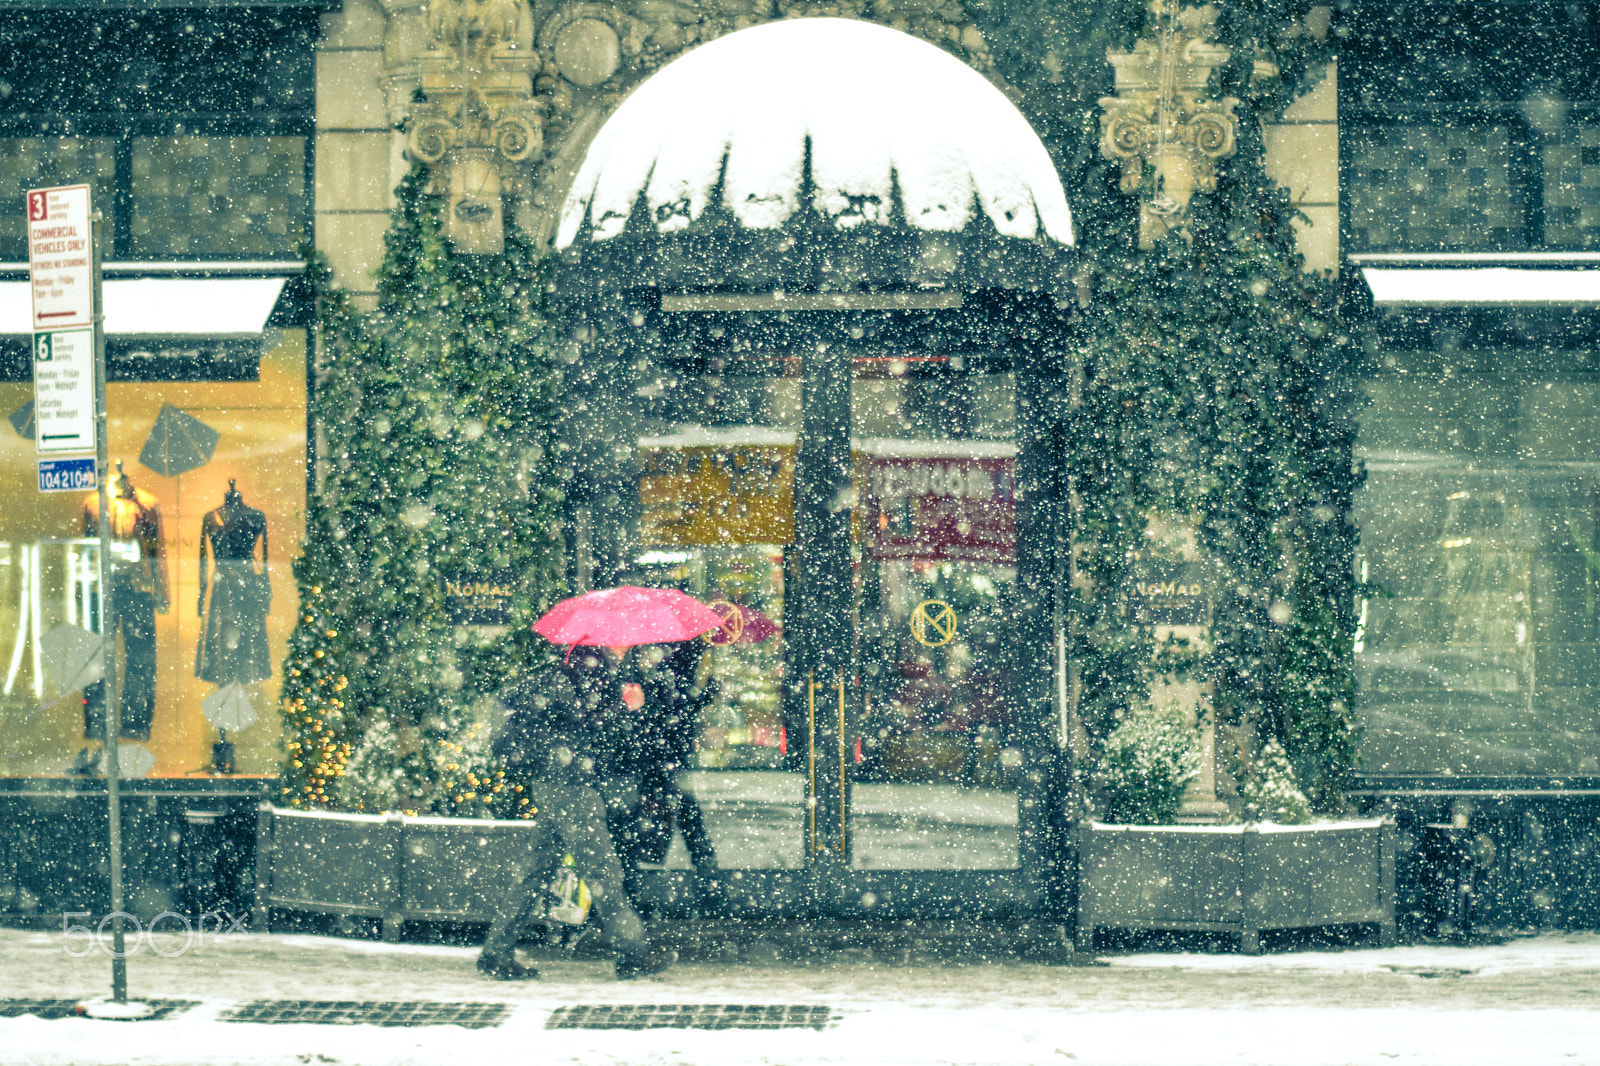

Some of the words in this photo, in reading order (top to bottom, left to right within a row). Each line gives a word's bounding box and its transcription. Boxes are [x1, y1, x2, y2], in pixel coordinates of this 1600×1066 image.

[33, 193, 43, 220] 3
[33, 226, 78, 240] COMMERCIAL
[33, 241, 65, 254] VEHICLES
[68, 240, 85, 251] ONLY
[34, 261, 53, 270] OTHERS
[54, 260, 61, 268] NO
[63, 258, 87, 268] STANDING
[59, 275, 75, 285] Friday
[38, 334, 48, 359] 6
[38, 370, 58, 379] Monday
[63, 369, 80, 378] Friday
[55, 381, 78, 391] Midnight
[40, 399, 62, 408] Saturday
[56, 409, 78, 419] Midnight
[41, 470, 82, 488] 104210
